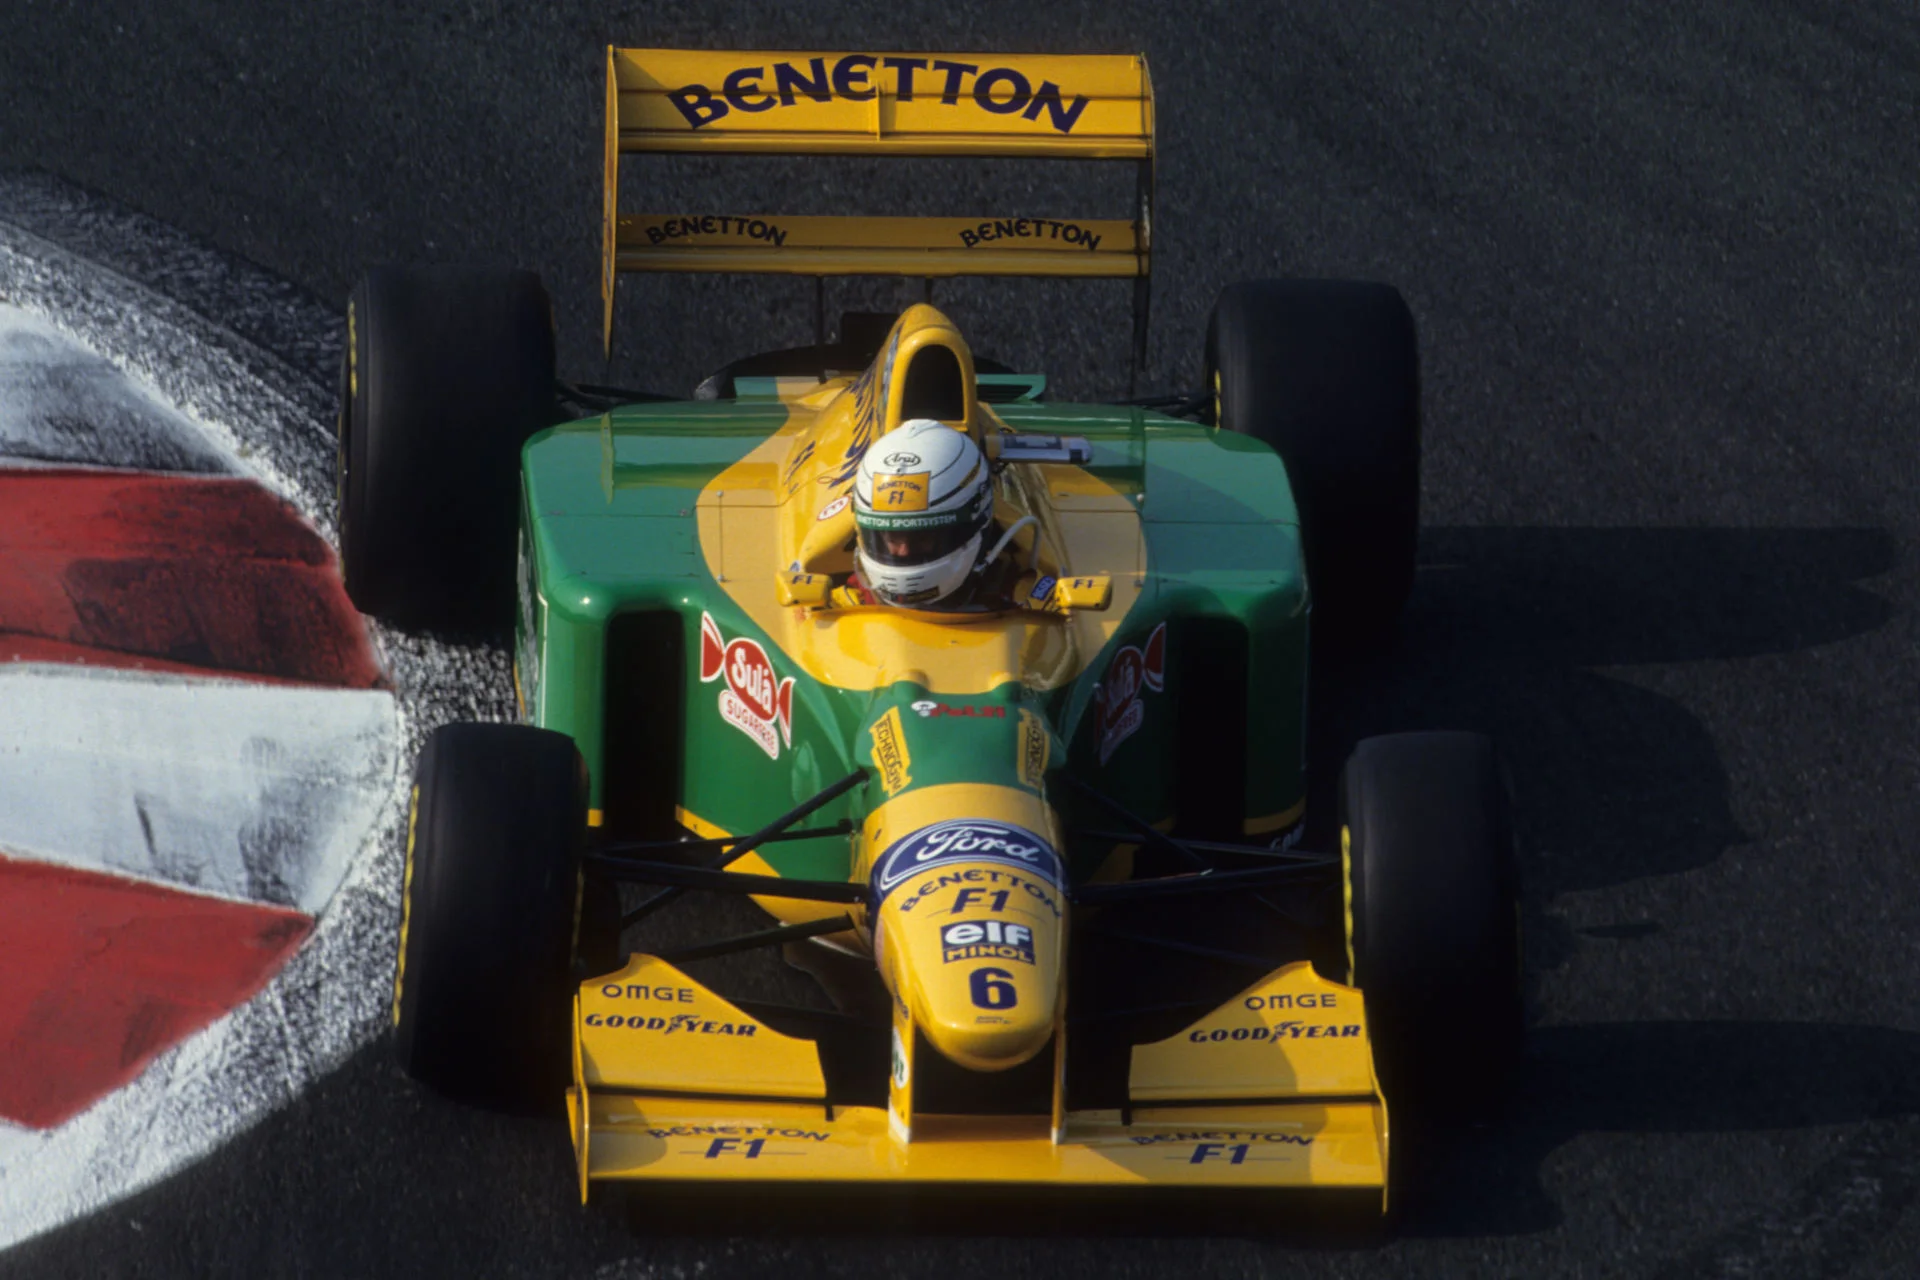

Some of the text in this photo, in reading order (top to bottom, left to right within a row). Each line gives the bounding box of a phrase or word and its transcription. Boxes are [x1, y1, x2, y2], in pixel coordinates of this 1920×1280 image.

[666, 54, 1090, 135] BENETTON
[645, 216, 787, 247] BENETTON
[958, 219, 1102, 251] BENETTON
[887, 490, 905, 505] F1
[792, 574, 813, 585] F1
[1072, 579, 1094, 589] F1
[915, 825, 1040, 862] Ford
[900, 868, 1063, 918] BENETTON
[951, 887, 1010, 915] F1
[945, 920, 1030, 945] elf
[946, 945, 1033, 962] MINOL
[969, 967, 1018, 1011] 6
[648, 1126, 831, 1142] BENETTON
[1130, 1131, 1314, 1147] BENETTON
[705, 1138, 767, 1159] F1
[1189, 1143, 1250, 1165] F1
